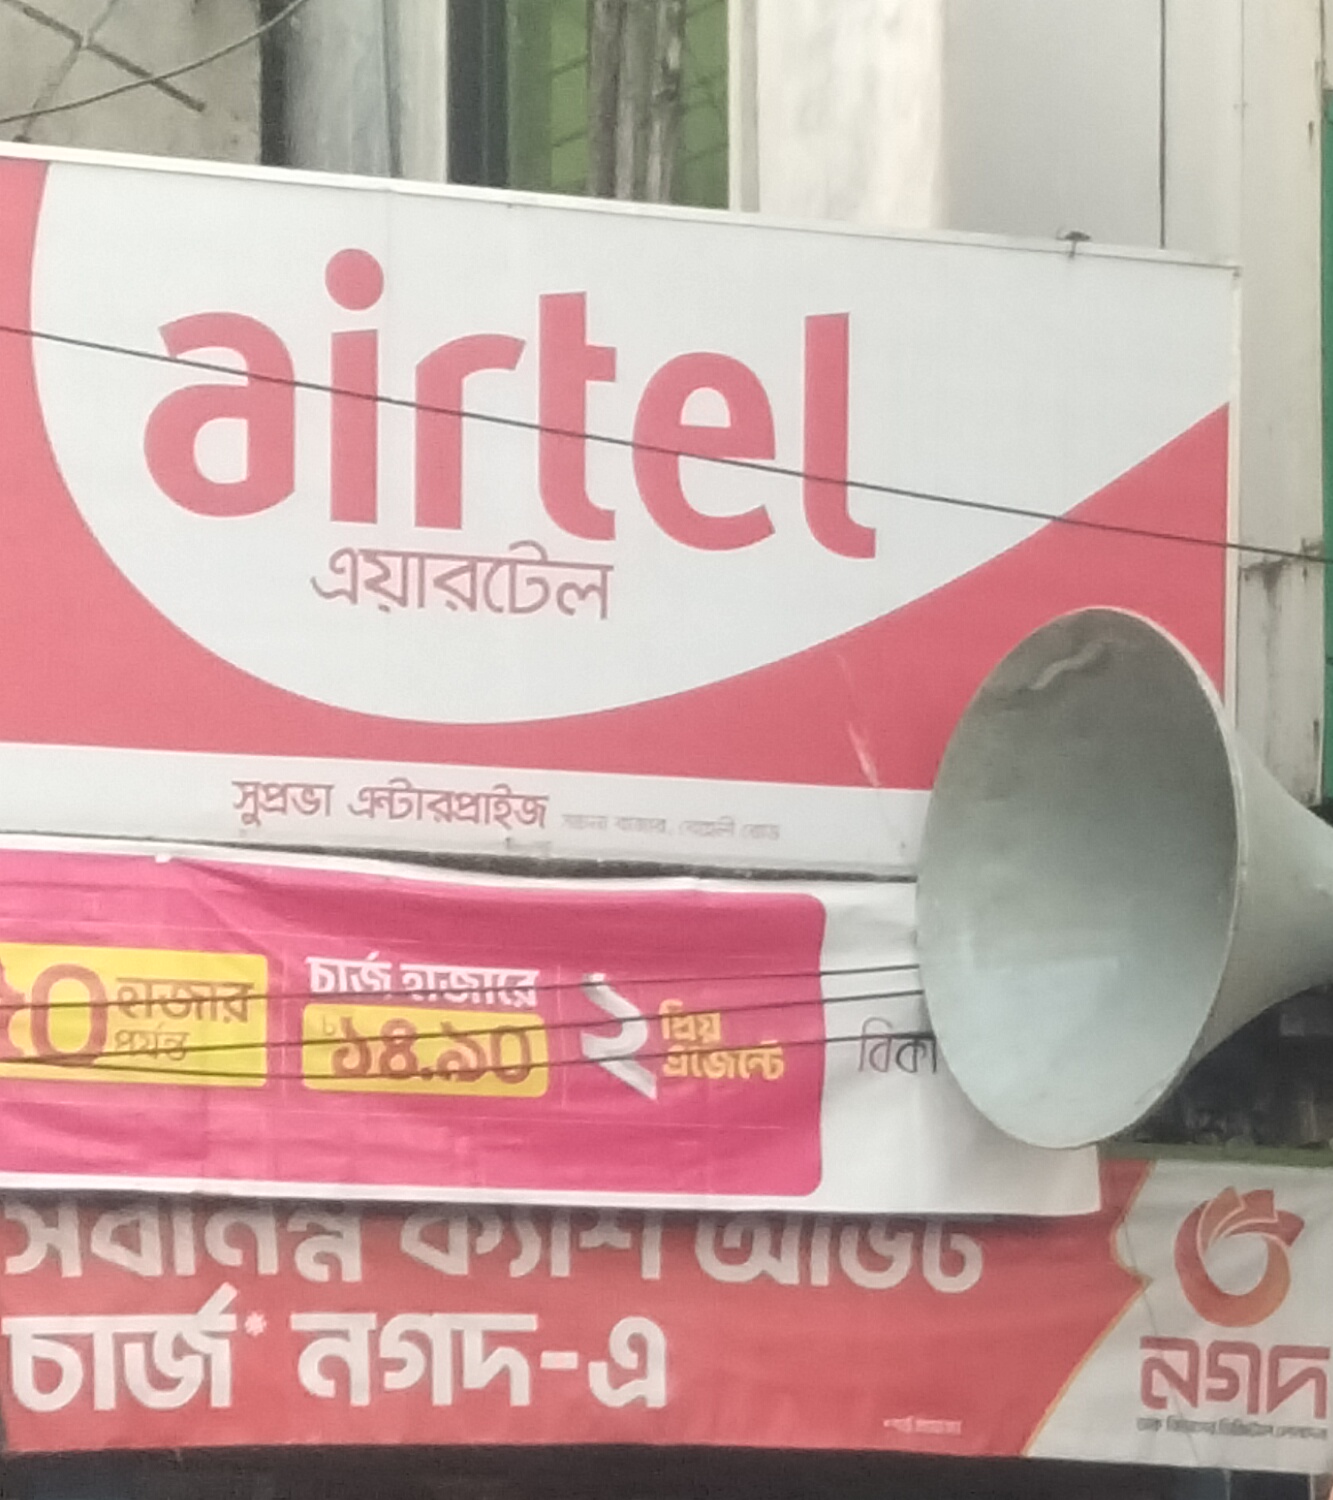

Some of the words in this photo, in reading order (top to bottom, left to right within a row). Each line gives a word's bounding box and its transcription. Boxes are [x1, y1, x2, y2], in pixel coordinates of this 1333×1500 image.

[143, 247, 877, 559] airtel
[310, 540, 615, 620] এয়ারটেল
[232, 779, 333, 827] সুপ্রভা
[347, 777, 549, 830] এন্টারপ্রাইজ
[115, 976, 254, 1024] হাজার
[305, 951, 393, 1000] চার্জ
[399, 964, 541, 1008] হাজারে
[858, 1016, 937, 1074] বিকা
[290, 1311, 668, 1409] নগদ-এ
[1139, 1335, 1331, 1420] নগদ
